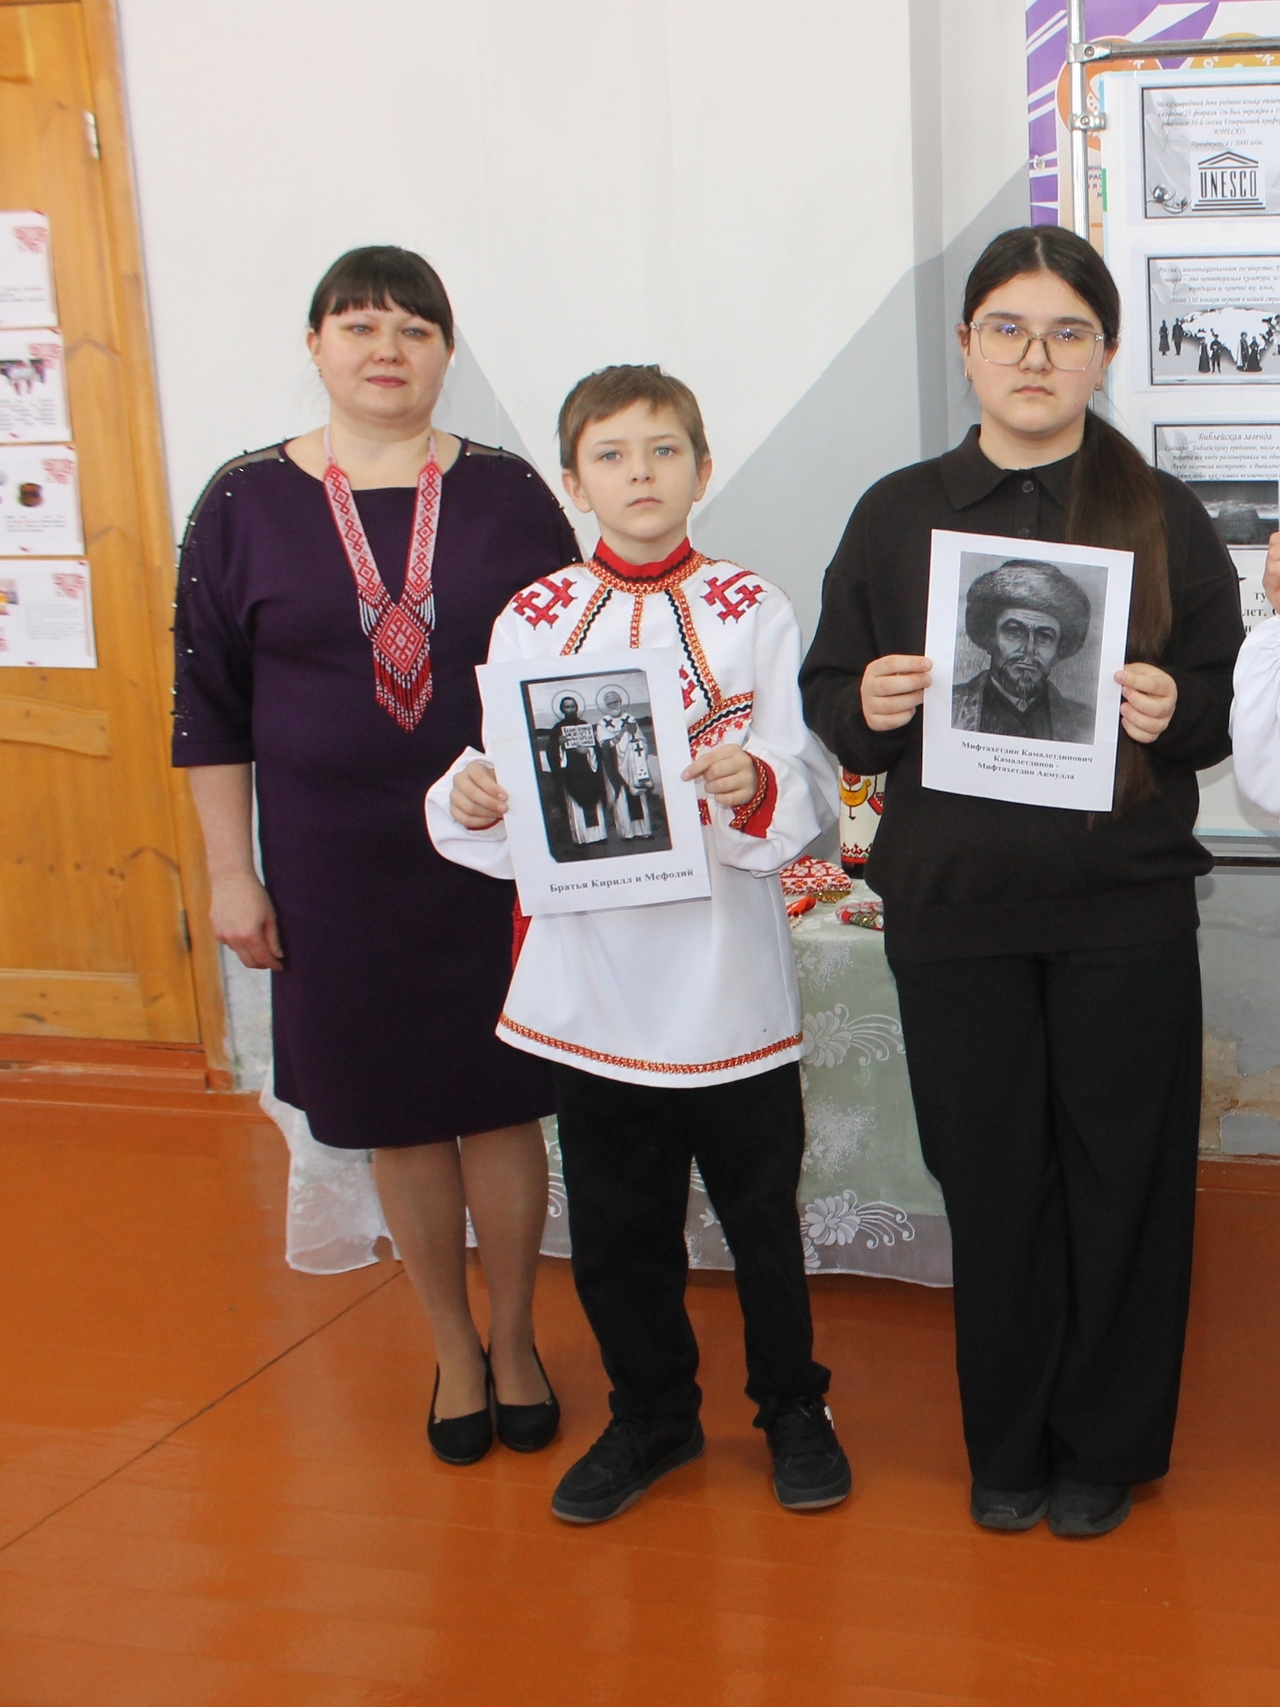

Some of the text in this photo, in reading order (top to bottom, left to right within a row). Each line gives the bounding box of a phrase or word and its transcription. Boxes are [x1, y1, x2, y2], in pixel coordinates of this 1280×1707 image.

[1199, 170, 1257, 198] UNESCO
[1198, 432, 1273, 442] Библейская легенда
[961, 741, 1093, 764] Мифтахетдин Камалетдинович
[993, 755, 1054, 769] Камалетдинов
[977, 762, 1075, 781] Мифтахетдин Акмулла
[549, 881, 588, 894] Братья
[591, 876, 632, 890] Кирилл
[644, 868, 694, 883] Мефодий
